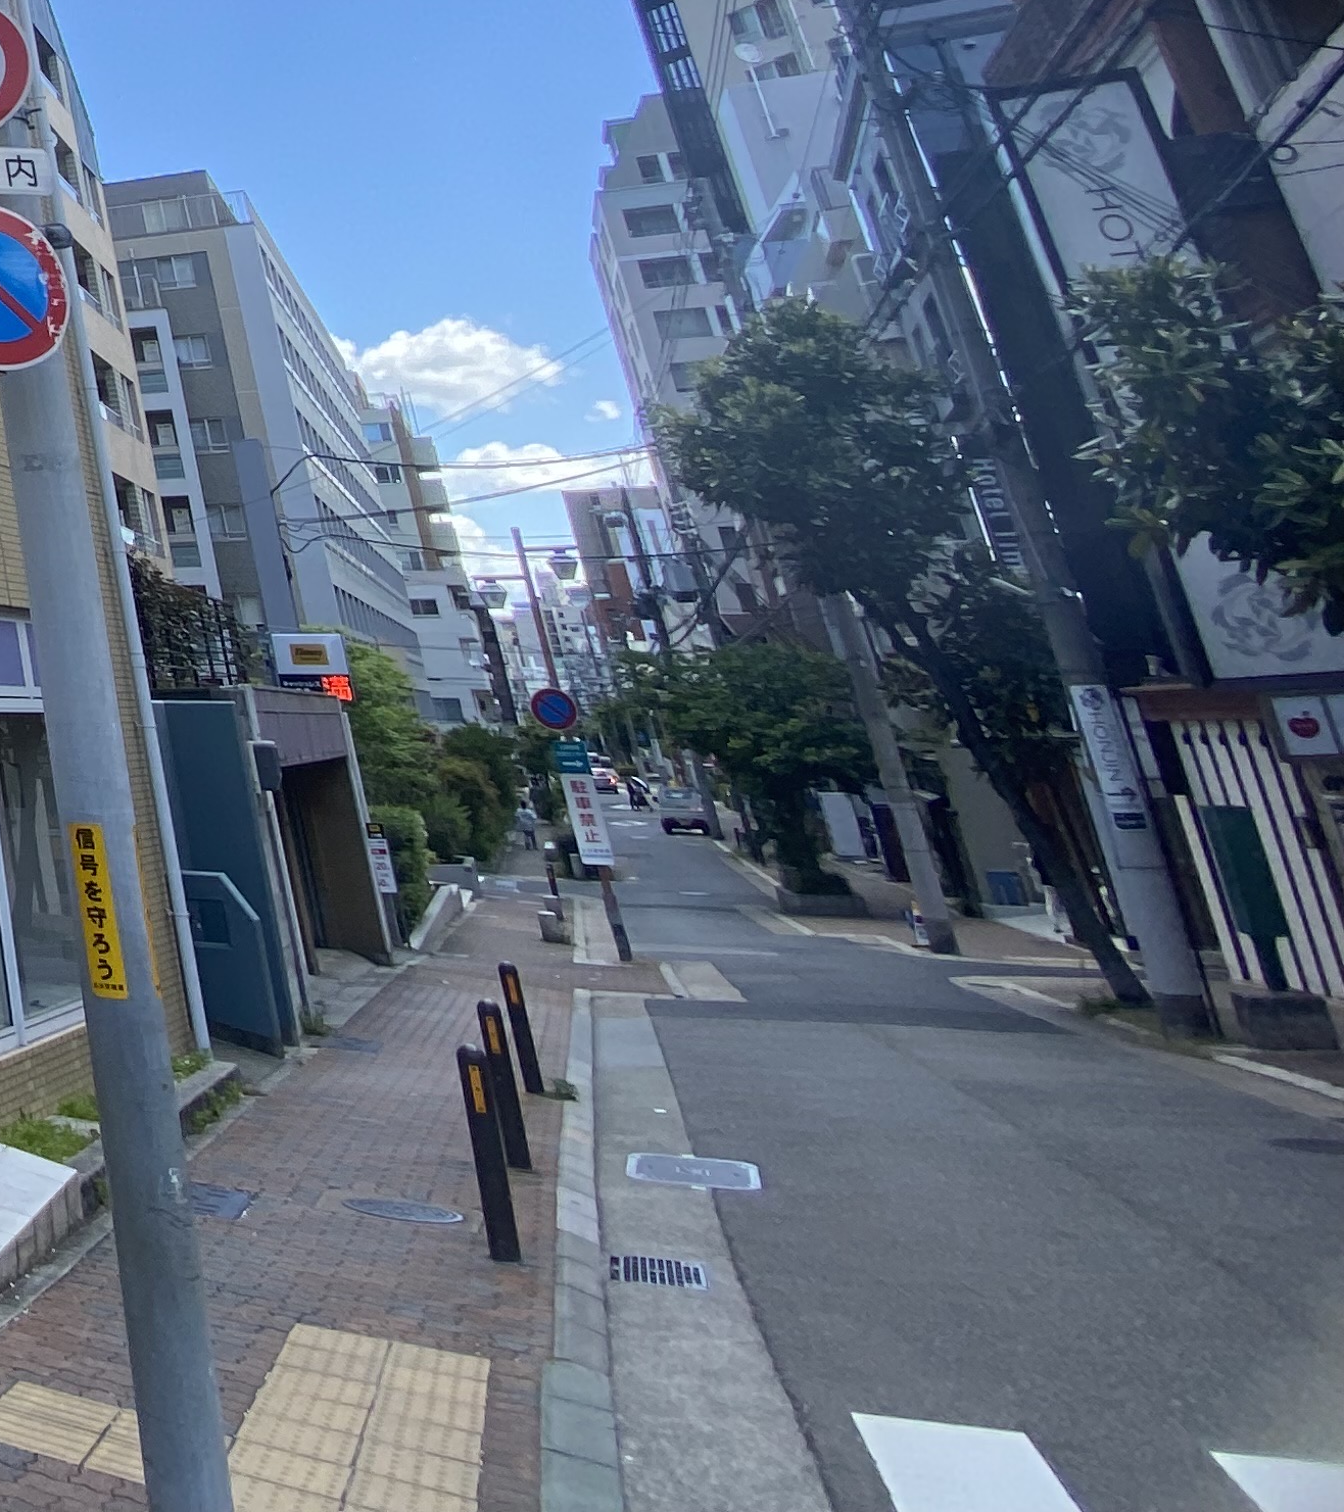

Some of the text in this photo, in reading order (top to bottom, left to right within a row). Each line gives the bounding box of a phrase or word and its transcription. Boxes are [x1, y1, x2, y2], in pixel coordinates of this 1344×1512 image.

[972, 457, 1011, 517] Hotel
[1087, 711, 1124, 782] HONJIN
[75, 828, 113, 981] 信号を守ろう
